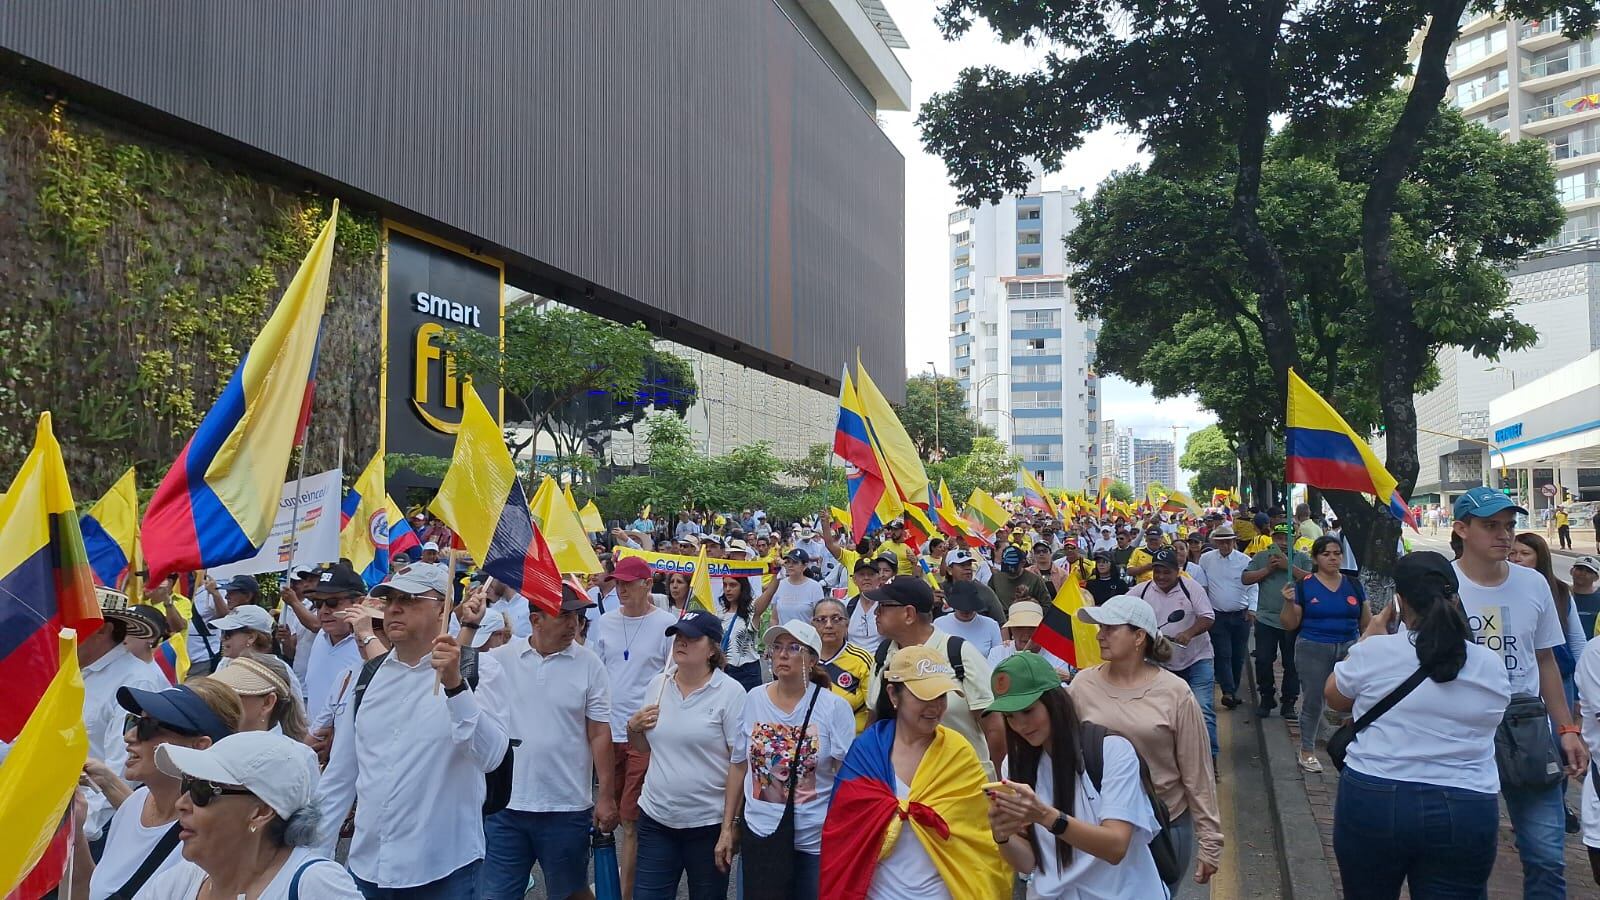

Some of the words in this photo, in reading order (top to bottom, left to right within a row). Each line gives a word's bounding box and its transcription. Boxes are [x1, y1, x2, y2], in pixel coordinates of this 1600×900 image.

[417, 291, 480, 328] smart
[416, 322, 472, 408] fi
[655, 558, 730, 574] COLOBIA
[1468, 615, 1496, 631] OX
[1476, 635, 1518, 651] FOR
